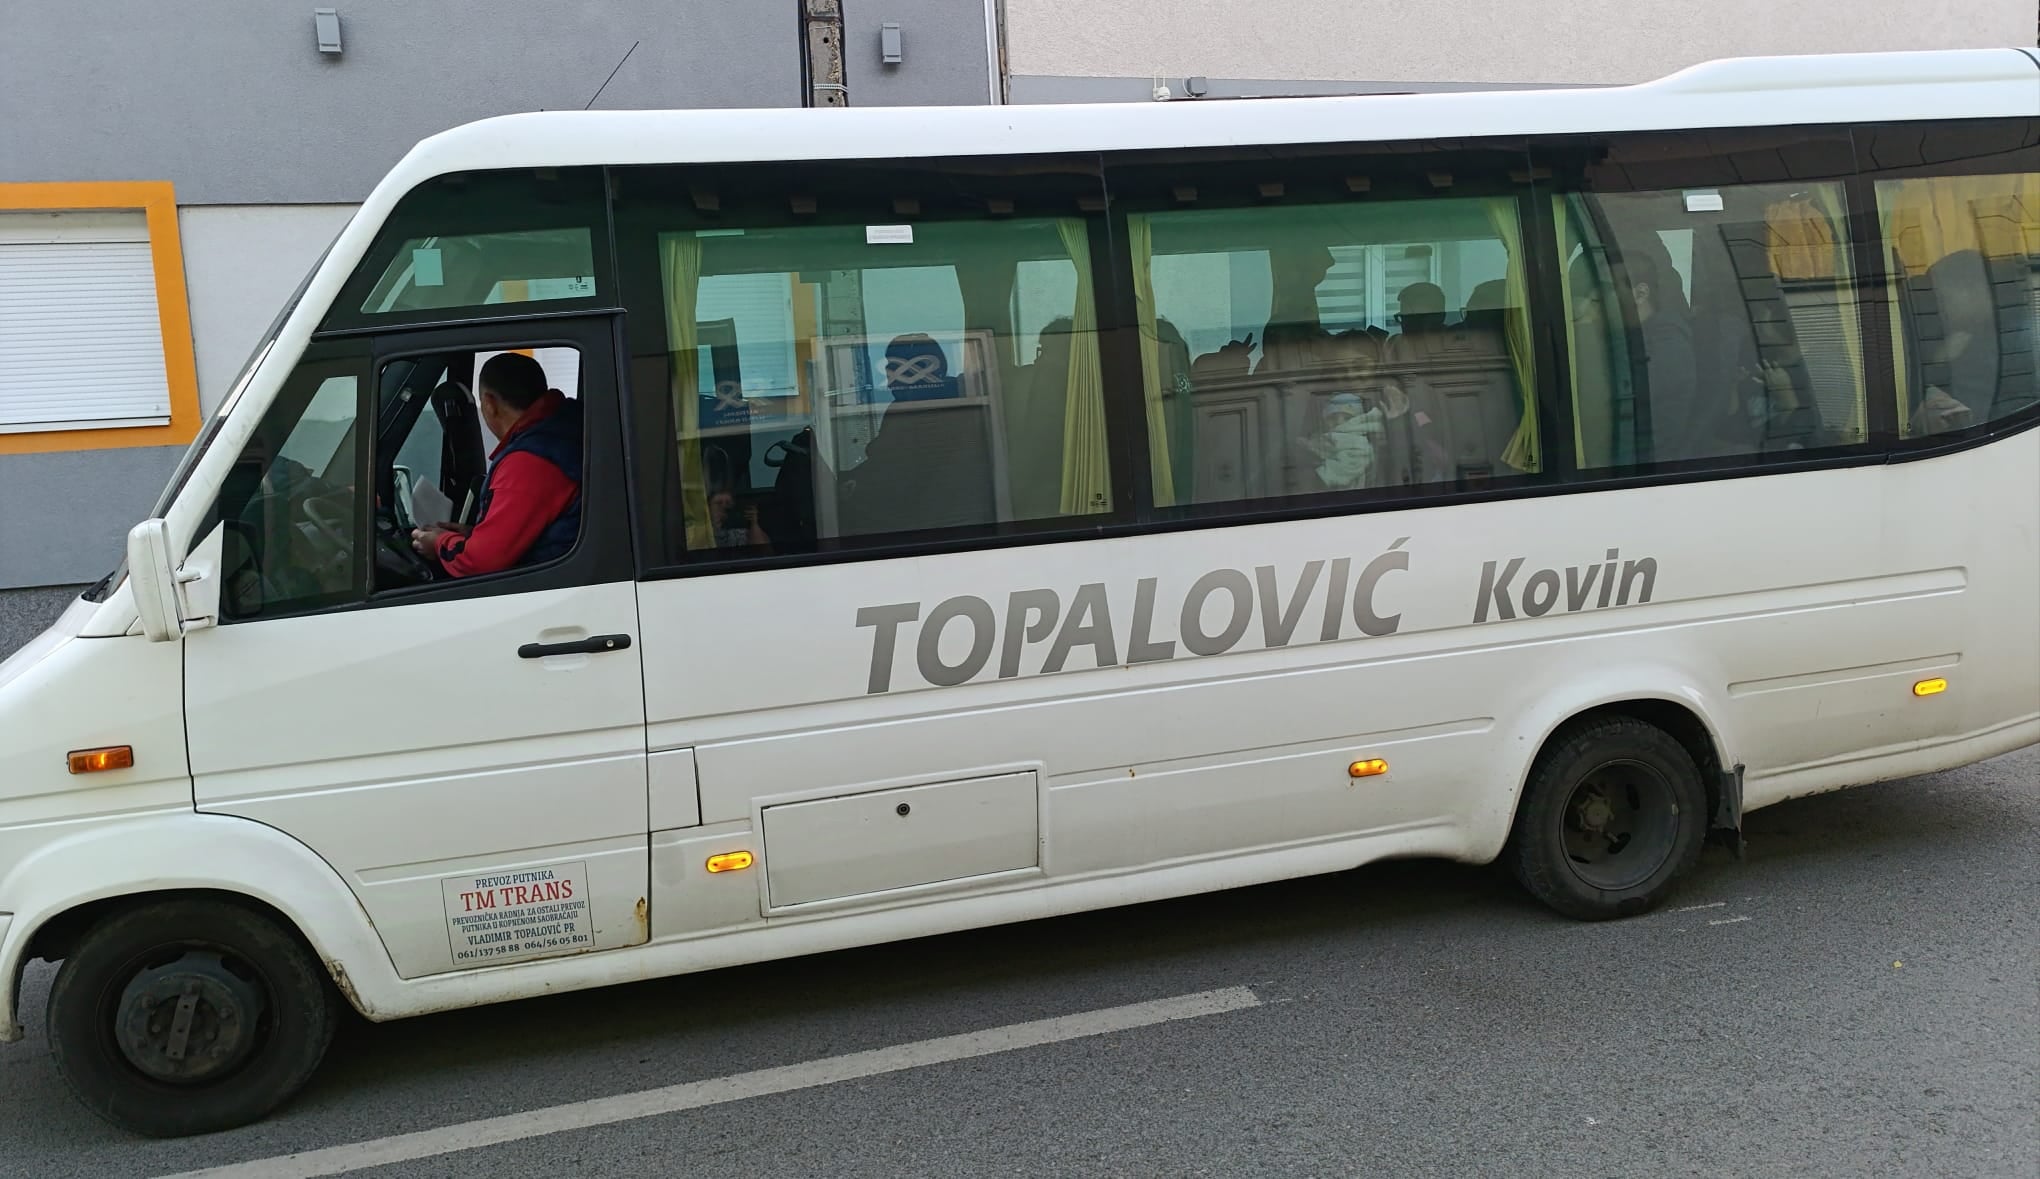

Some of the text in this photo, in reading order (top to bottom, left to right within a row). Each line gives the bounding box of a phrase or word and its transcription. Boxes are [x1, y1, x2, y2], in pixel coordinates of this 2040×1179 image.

[855, 537, 1657, 694] TOPALOVIĆ Kovin
[475, 870, 554, 888] PREVOZ PUTNIKA
[460, 880, 573, 911] TM TRANS
[452, 912, 498, 925] PREVOZNIČKA
[527, 907, 536, 916] ZA
[537, 904, 560, 914] OSTALI
[561, 901, 585, 911] PREVOZ
[462, 922, 492, 933] PUTNIKA
[499, 916, 536, 928] KOPNENOM
[468, 922, 575, 945] VLADIMIR TOPALOVIĆ PR
[457, 934, 588, 959] 061/137 58 88 064/56 05 801
